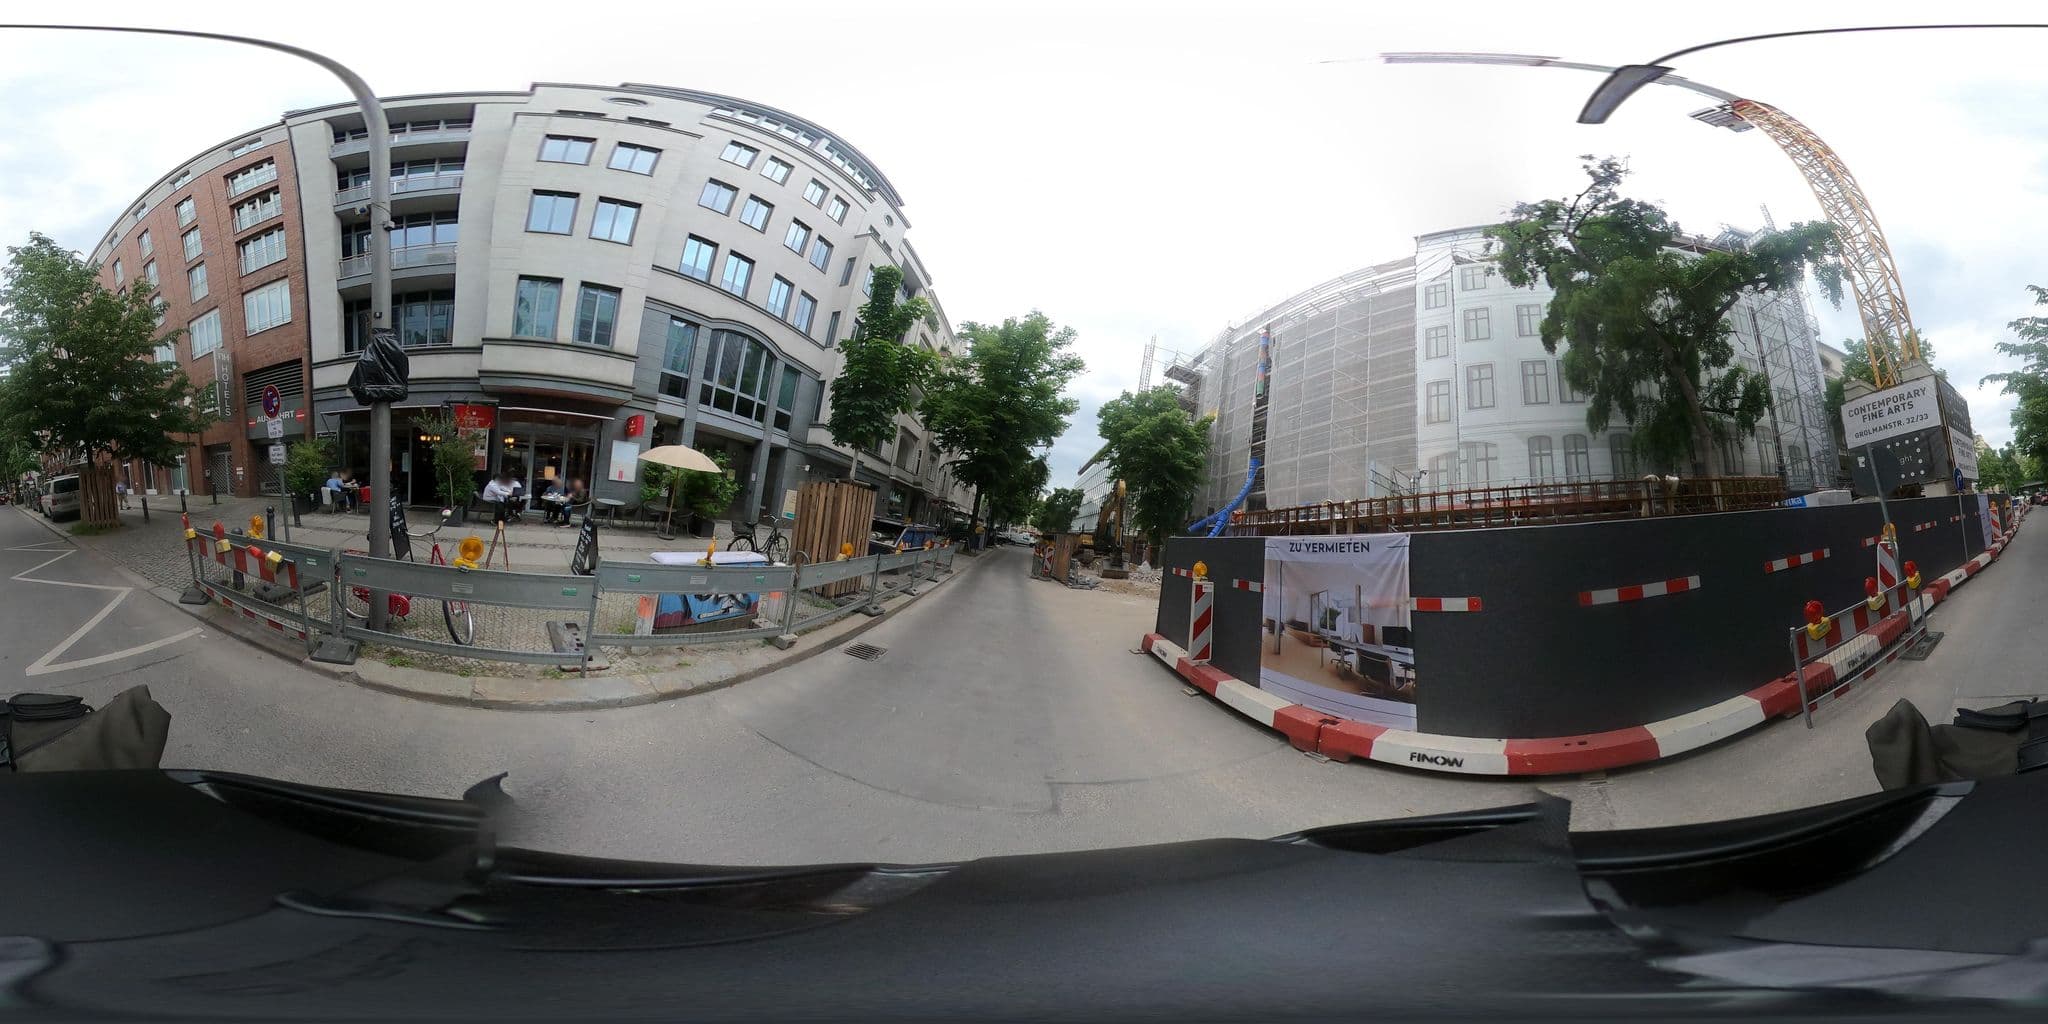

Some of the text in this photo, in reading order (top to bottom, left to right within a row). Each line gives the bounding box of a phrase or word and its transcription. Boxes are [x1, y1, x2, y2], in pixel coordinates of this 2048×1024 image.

[222, 364, 231, 416] HOTELS
[1848, 387, 1927, 418] CONTEMPORARY
[1861, 401, 1914, 423] FINE ARTS
[256, 410, 295, 423] AUSHRT
[1854, 420, 1905, 439] GROLMANSTR.
[1289, 541, 1370, 553] ZU VERMIETEN
[1409, 752, 1465, 768] FINOW
